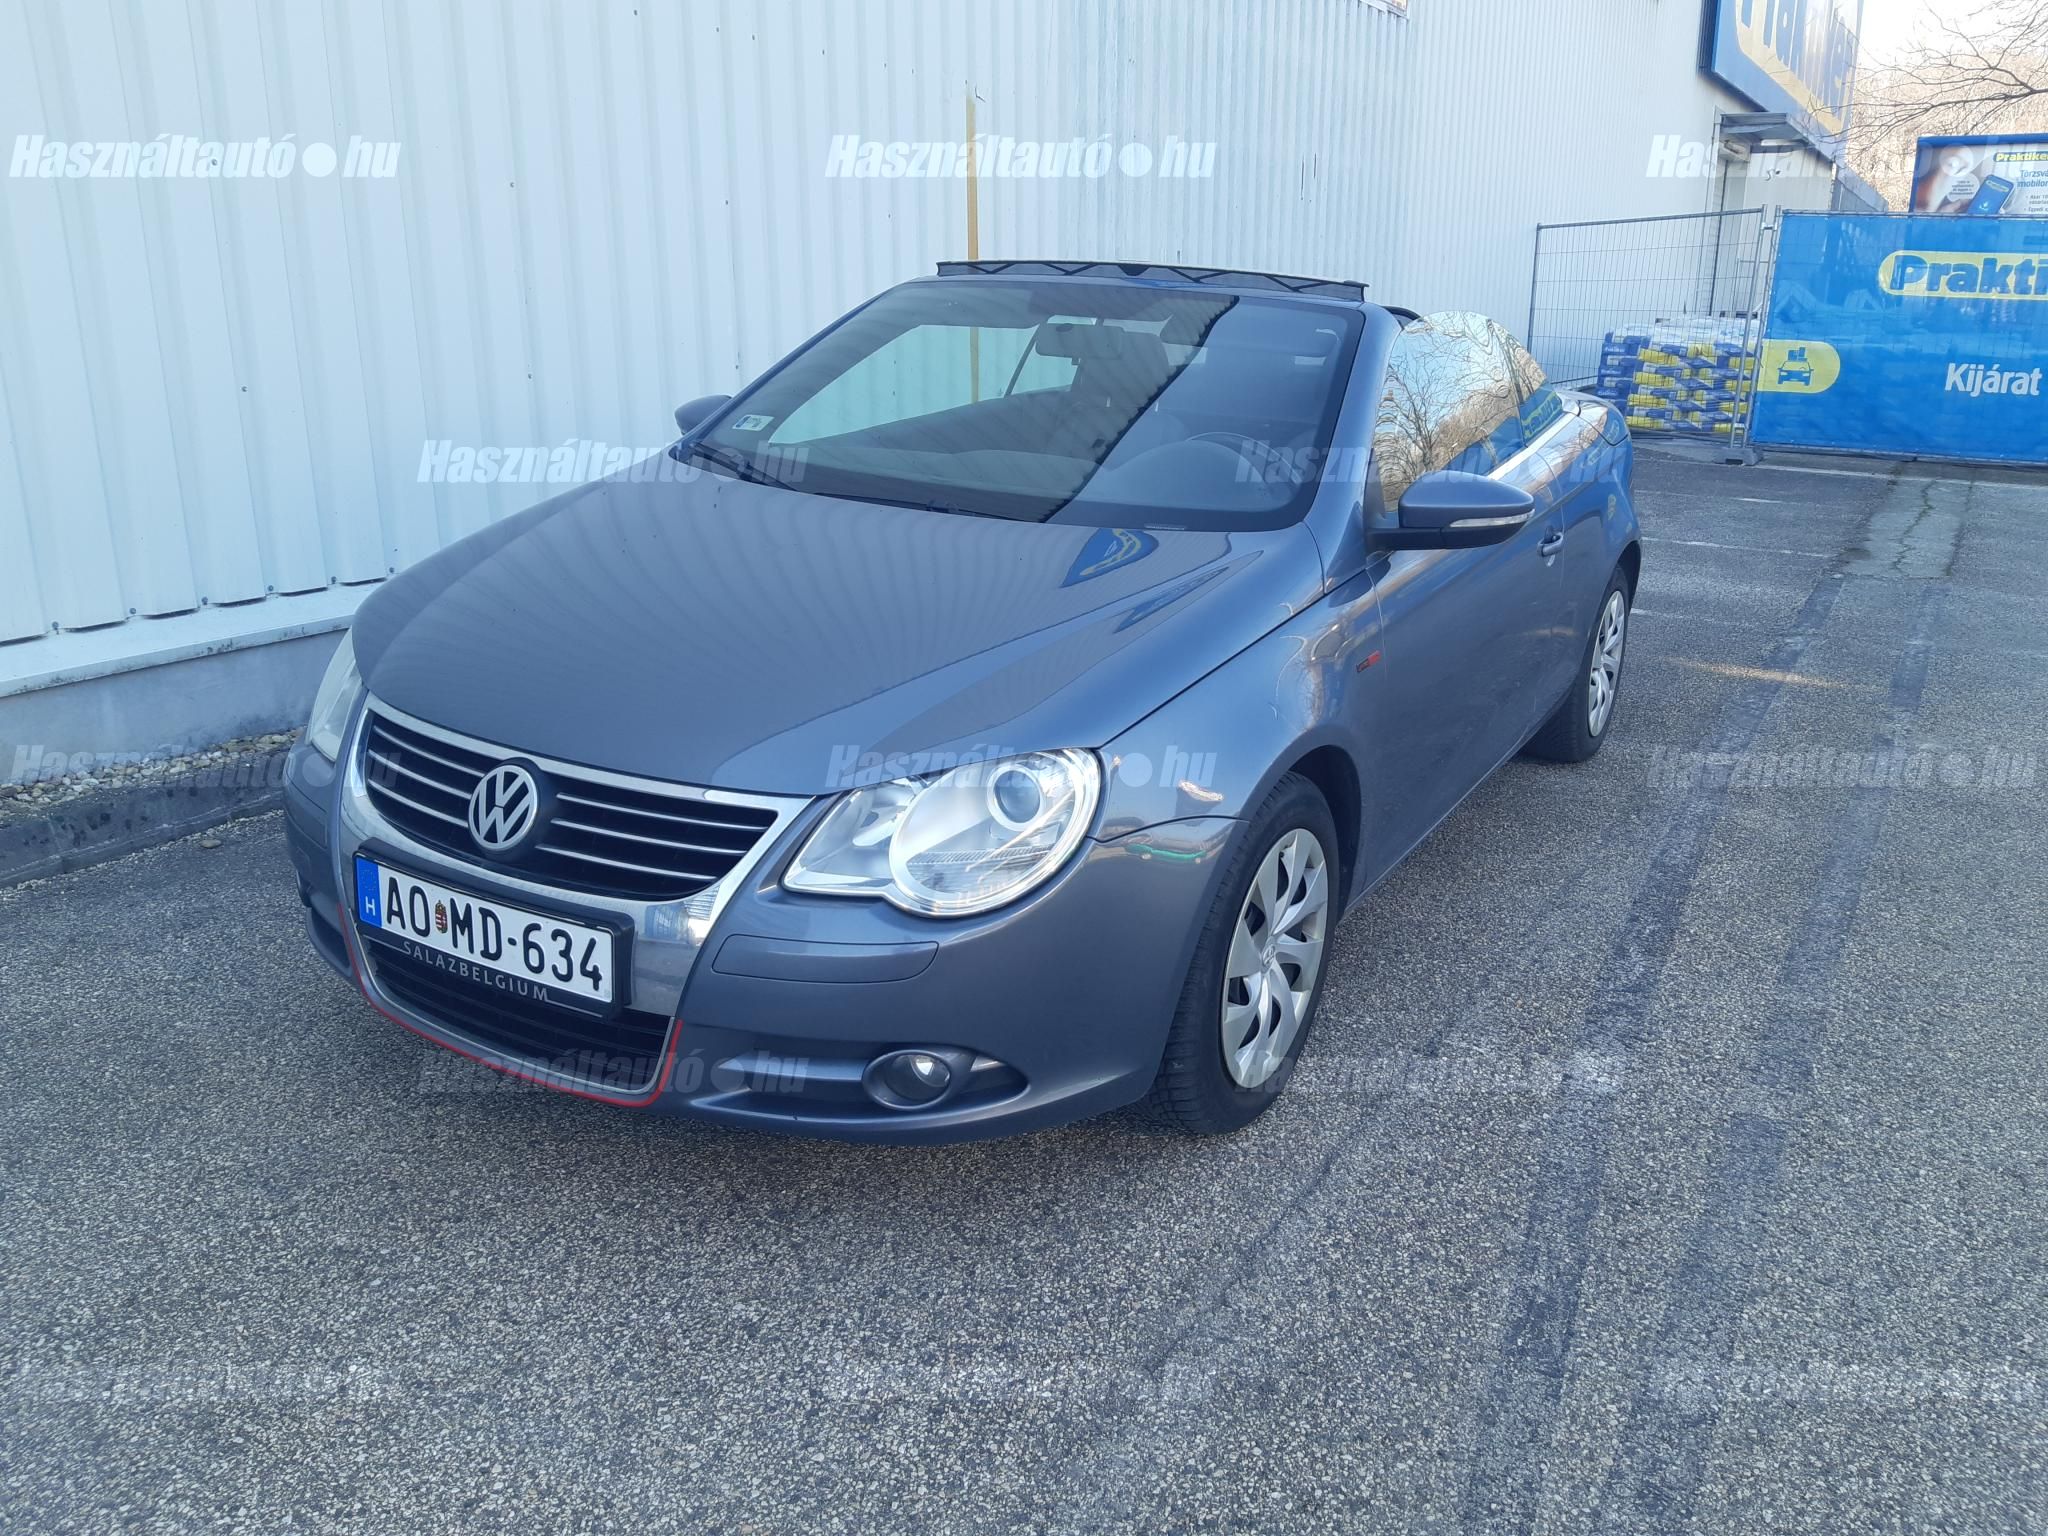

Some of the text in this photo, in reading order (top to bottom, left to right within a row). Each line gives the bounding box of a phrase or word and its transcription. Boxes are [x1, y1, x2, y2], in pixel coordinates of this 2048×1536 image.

[1996, 152, 2048, 161] Praktike
[1945, 362, 2043, 397] Kijárat
[364, 895, 377, 917] H
[386, 876, 603, 992] AO MD-634
[402, 940, 549, 1002] SALAZBELGIUM
